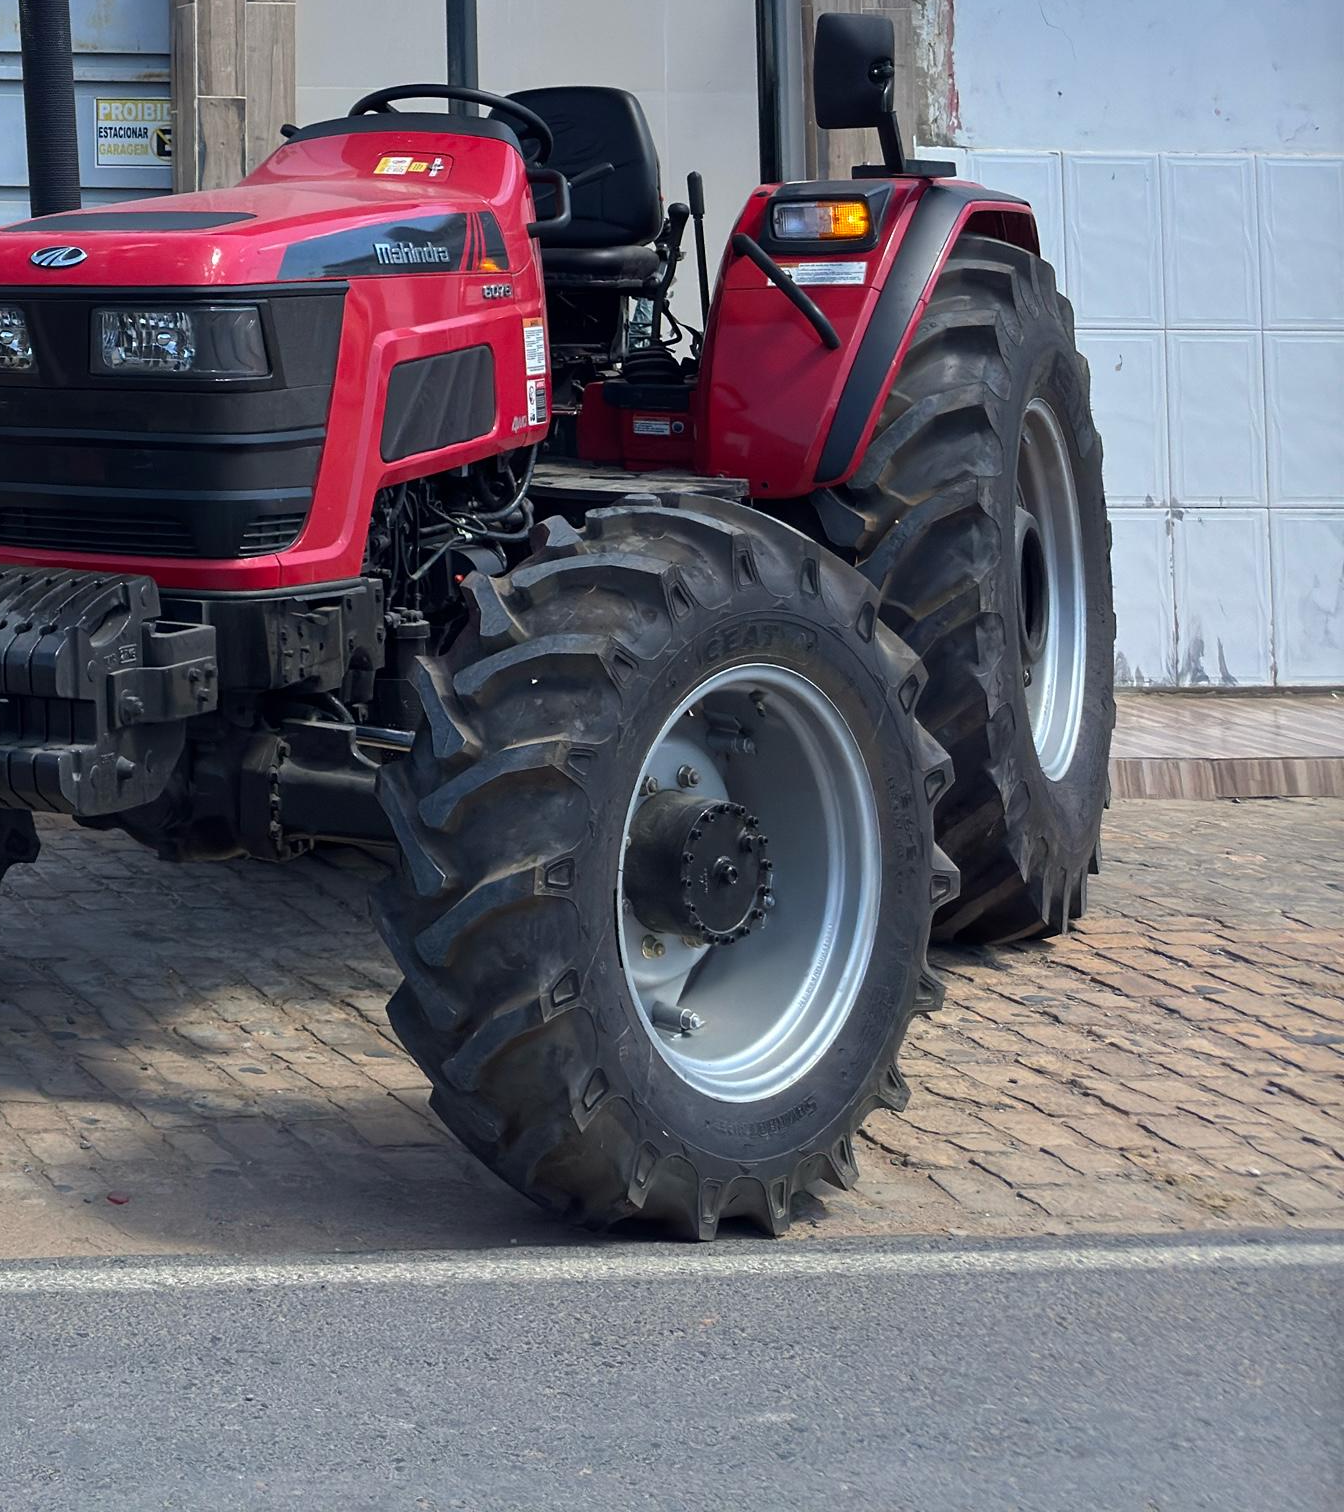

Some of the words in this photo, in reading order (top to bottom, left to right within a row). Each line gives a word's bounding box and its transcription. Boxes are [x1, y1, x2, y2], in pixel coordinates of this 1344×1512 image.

[99, 102, 172, 121] PROIBID
[98, 126, 149, 139] ESTACIONAR
[99, 143, 149, 156] GARAGEM
[373, 242, 451, 265] Mahindra
